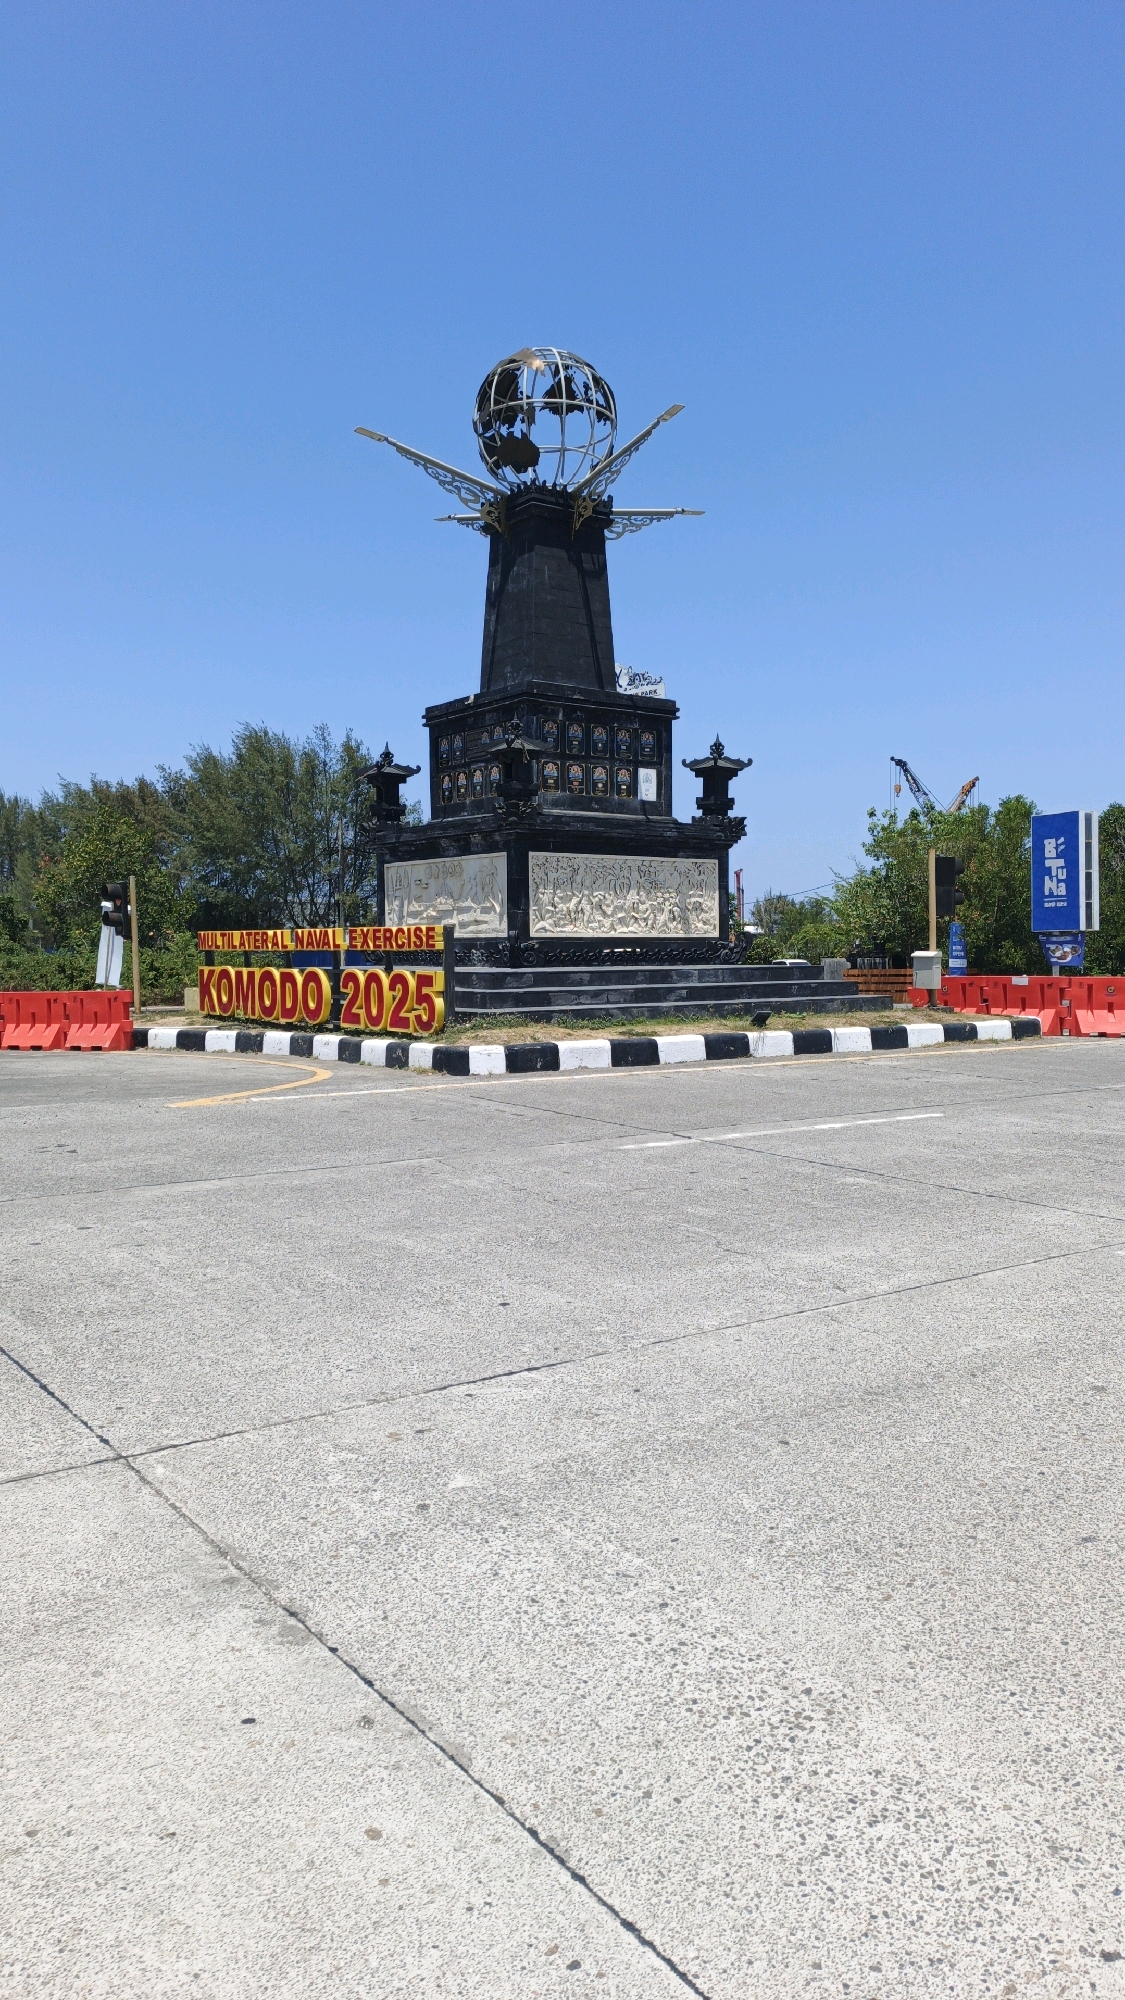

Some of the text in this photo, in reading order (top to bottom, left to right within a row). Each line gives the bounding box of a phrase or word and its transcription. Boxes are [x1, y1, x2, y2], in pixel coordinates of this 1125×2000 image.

[198, 926, 436, 950] MULTILATERAL NAVAL EXERCISE
[199, 966, 440, 1034] KOMODO 2025
